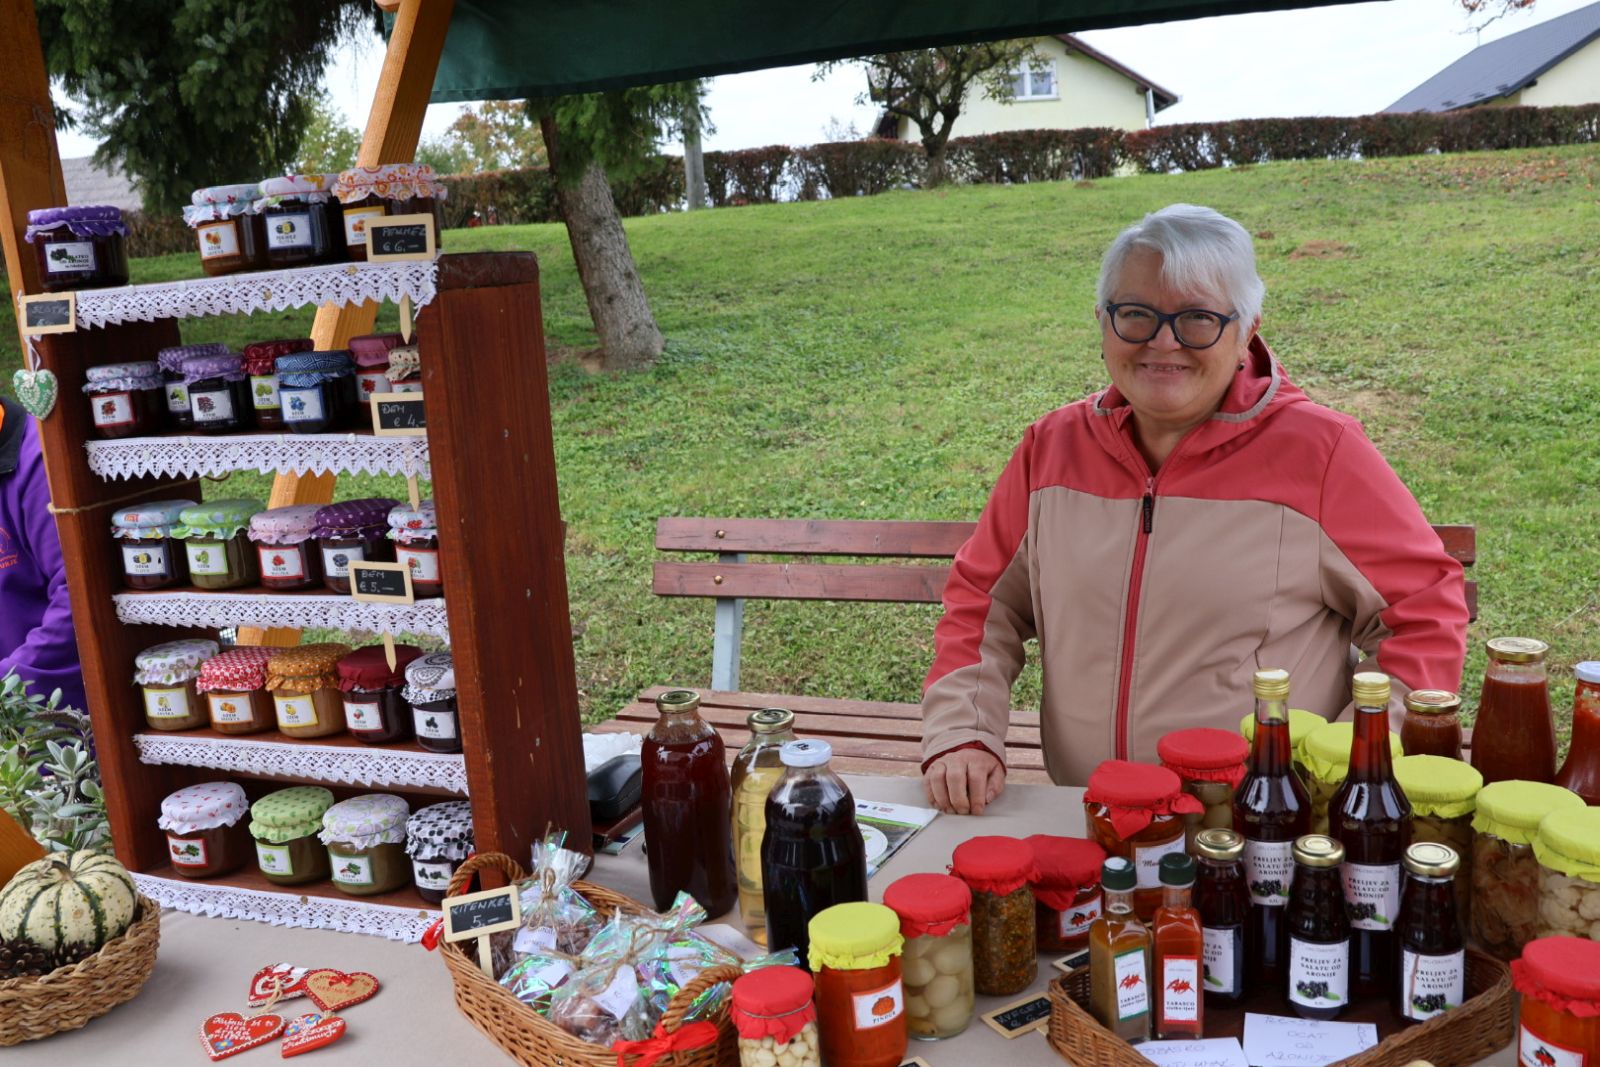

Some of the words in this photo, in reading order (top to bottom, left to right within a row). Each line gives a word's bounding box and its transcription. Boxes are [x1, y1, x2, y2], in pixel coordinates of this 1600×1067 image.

[1253, 855, 1282, 864] PRELJEV
[1253, 862, 1281, 870] SALATU
[1349, 877, 1378, 886] PRELJEV
[1349, 884, 1376, 893] SALATU
[1301, 956, 1331, 964] PRELJEV
[1120, 993, 1146, 1004] TABASCO
